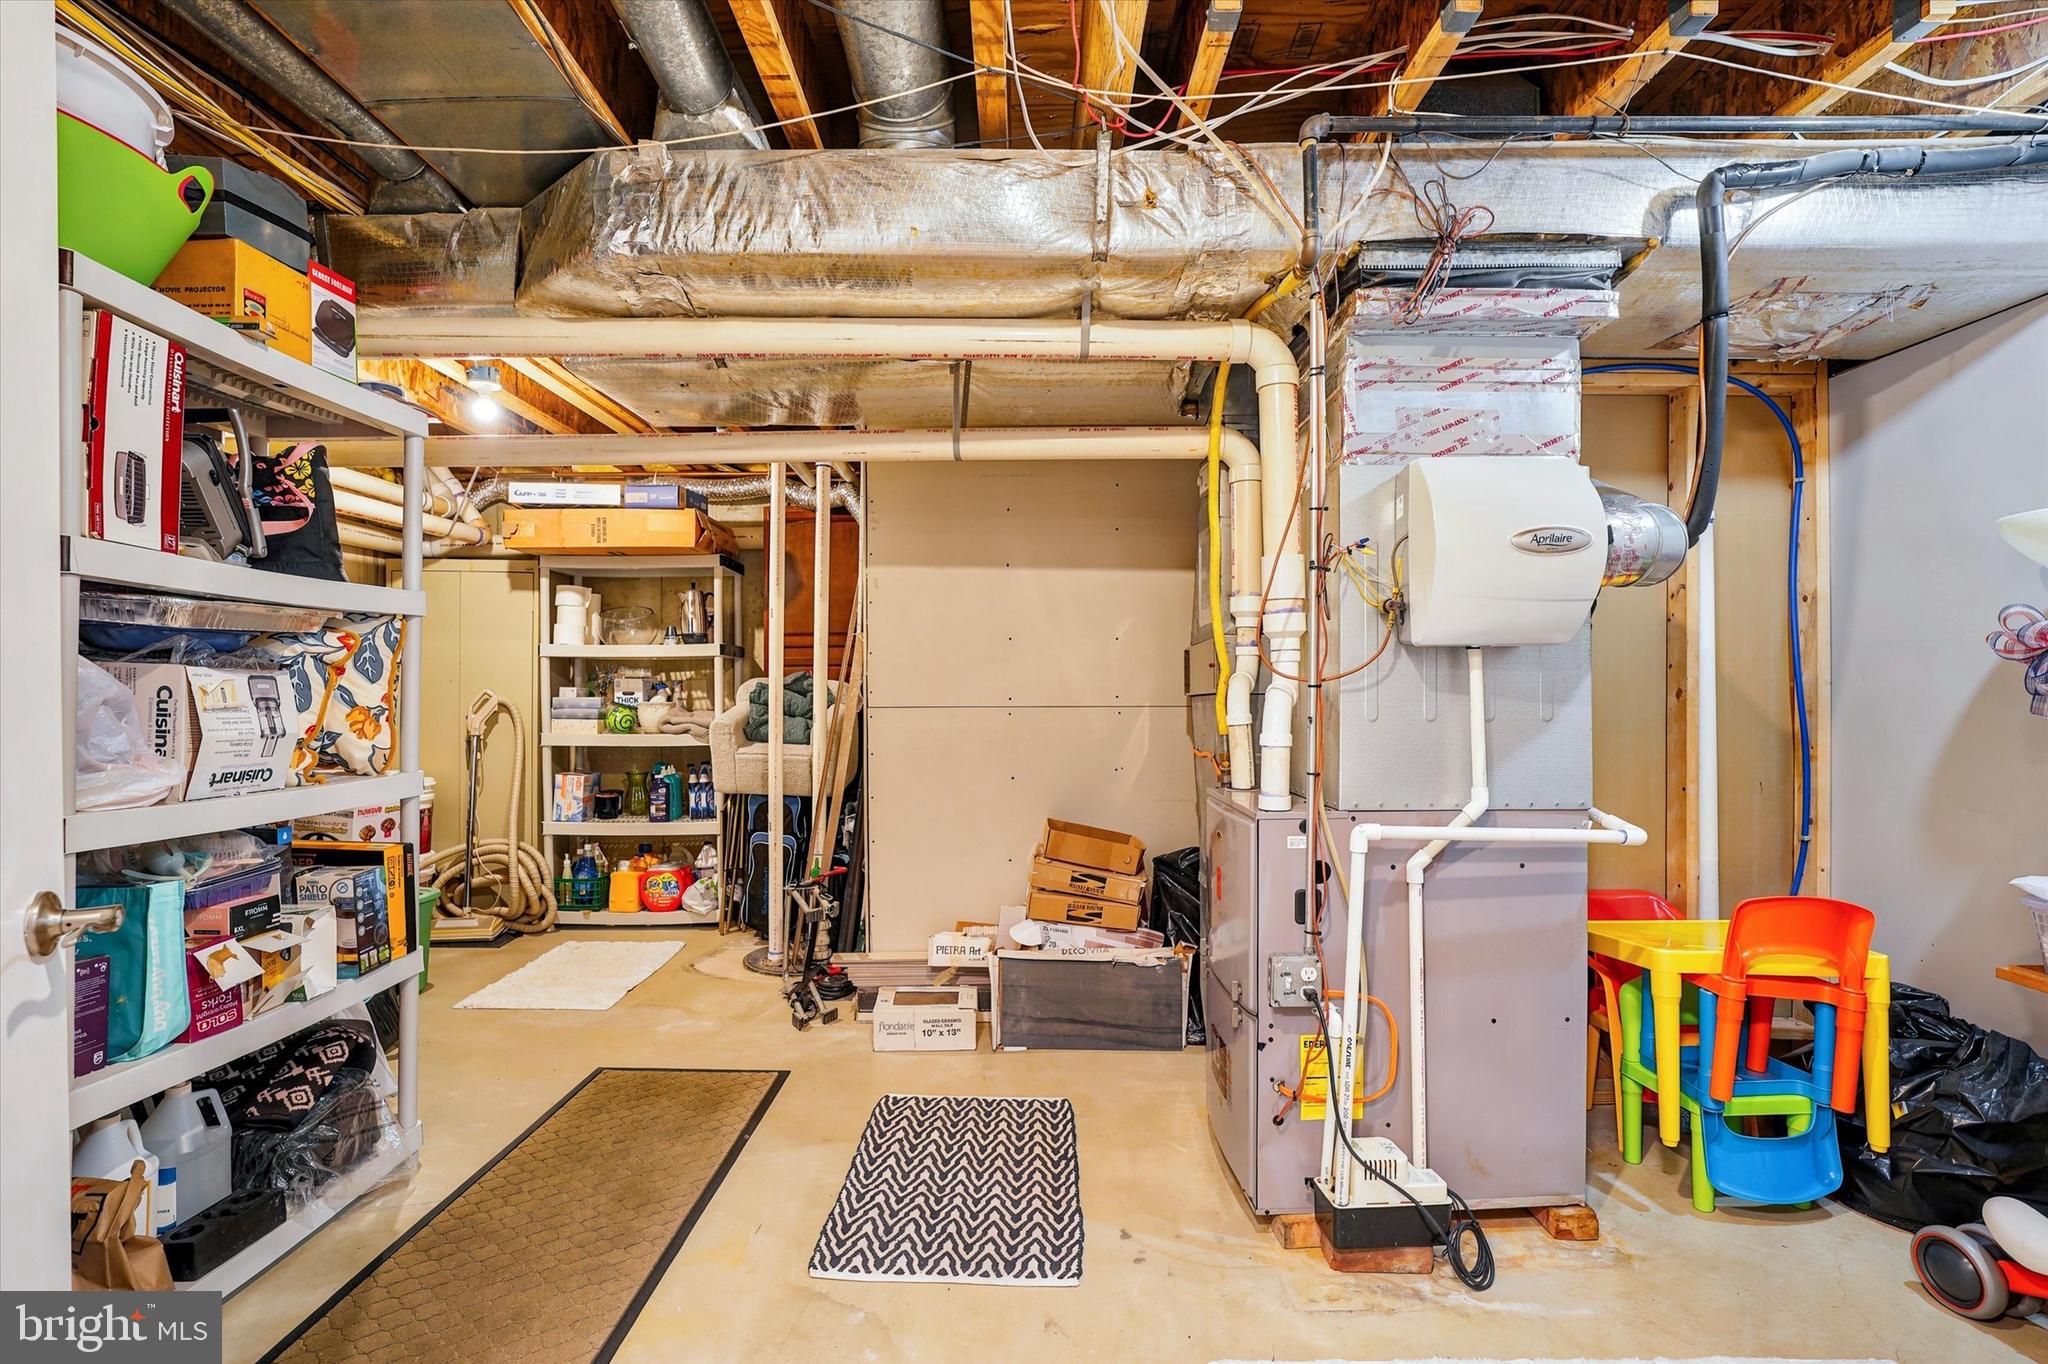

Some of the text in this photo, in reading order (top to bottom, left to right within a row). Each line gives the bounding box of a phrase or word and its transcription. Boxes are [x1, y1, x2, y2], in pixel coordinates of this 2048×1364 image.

[171, 352, 184, 414] Cuisinart
[1530, 533, 1573, 546] Aprilaire
[616, 696, 640, 704] THICK
[208, 767, 273, 788] Cuisinart
[299, 884, 328, 894] PATIO
[299, 893, 328, 901] SHIELD
[244, 905, 268, 917] FROMM
[936, 945, 982, 955] PIETRA Art
[1062, 947, 1085, 955] DECO
[201, 991, 232, 1010] Forks
[196, 1008, 238, 1033] SOLO
[922, 1029, 937, 1037] 10"
[946, 1028, 961, 1036] 13"
